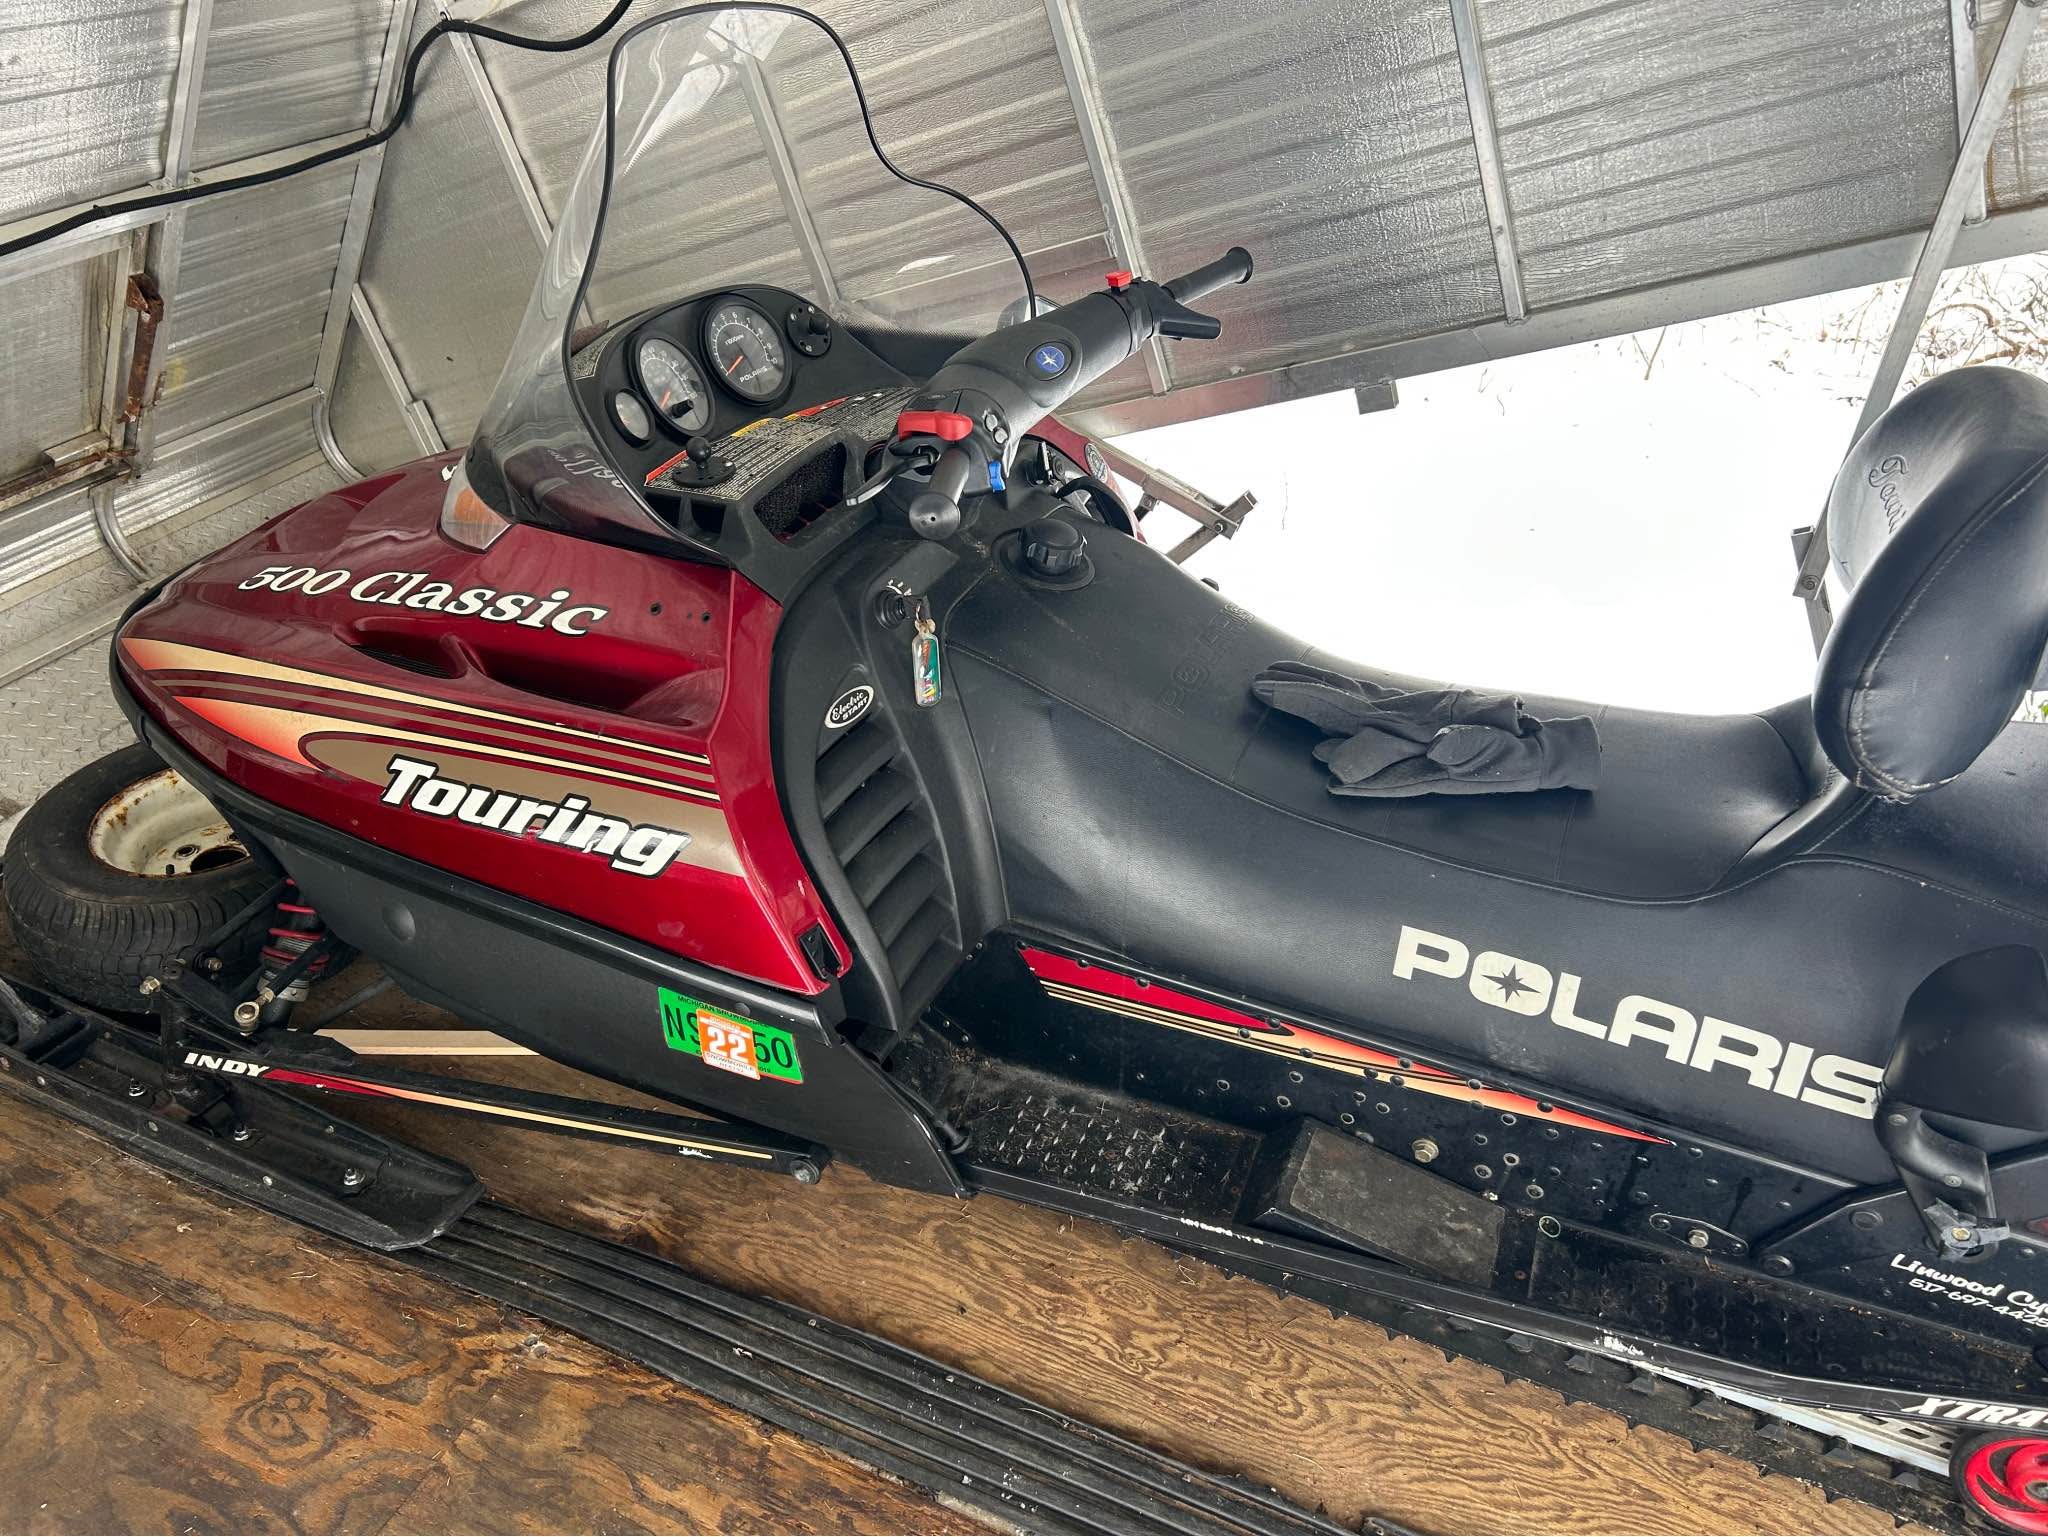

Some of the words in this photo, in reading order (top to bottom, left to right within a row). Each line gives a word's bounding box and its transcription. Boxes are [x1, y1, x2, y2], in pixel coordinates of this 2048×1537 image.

[237, 565, 351, 596] 500
[349, 571, 609, 636] Classic
[831, 692, 865, 721] Electric
[842, 697, 869, 721] START
[382, 755, 691, 878] Touring
[677, 995, 715, 1012] MICHIGAN
[1393, 925, 1884, 1120] POLARIS
[184, 1052, 271, 1077] INDY
[707, 1026, 749, 1064] 22
[1890, 1253, 2005, 1297] Linwood
[1908, 1277, 2048, 1328] 517-697-4425
